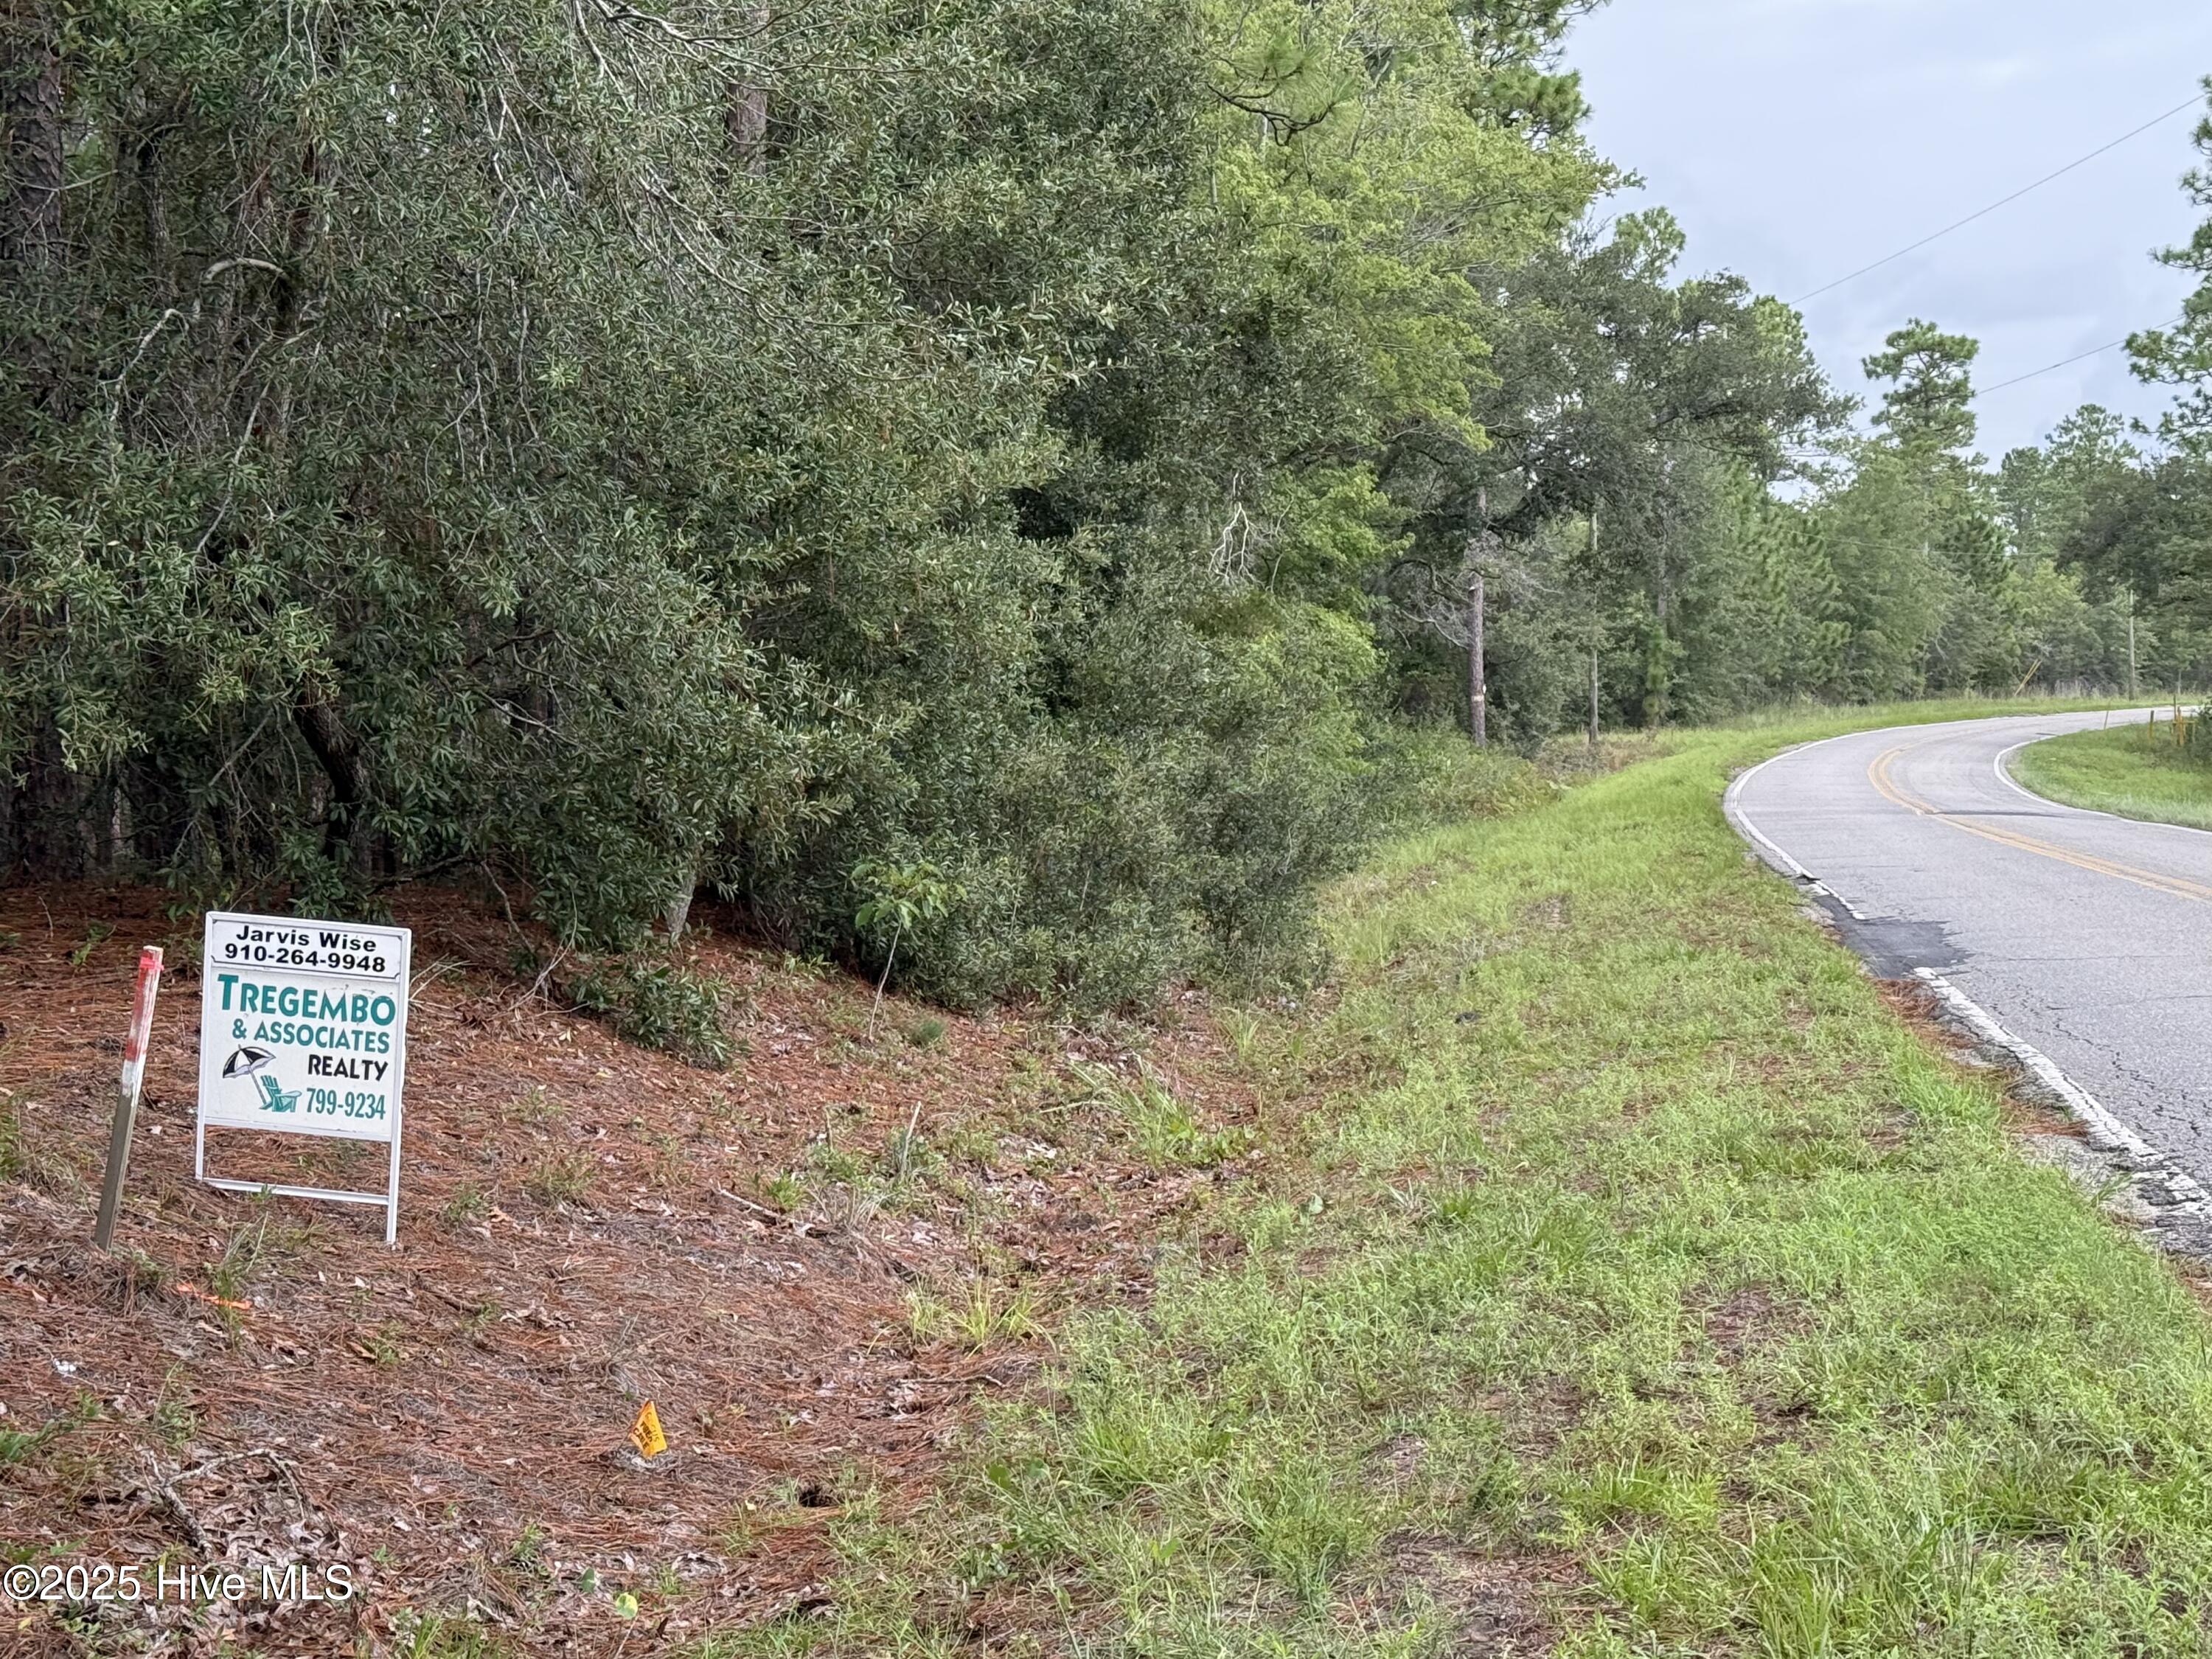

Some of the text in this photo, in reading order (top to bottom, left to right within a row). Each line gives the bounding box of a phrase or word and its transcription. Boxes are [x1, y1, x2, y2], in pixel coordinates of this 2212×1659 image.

[237, 925, 377, 952] Jarvis Wise
[225, 943, 386, 973] 910-264-9948
[218, 973, 396, 1026] TREGEMBO
[232, 1018, 390, 1054] & ASSOCIATES
[307, 1054, 389, 1082] REALTY
[307, 1088, 386, 1120] 799-9234
